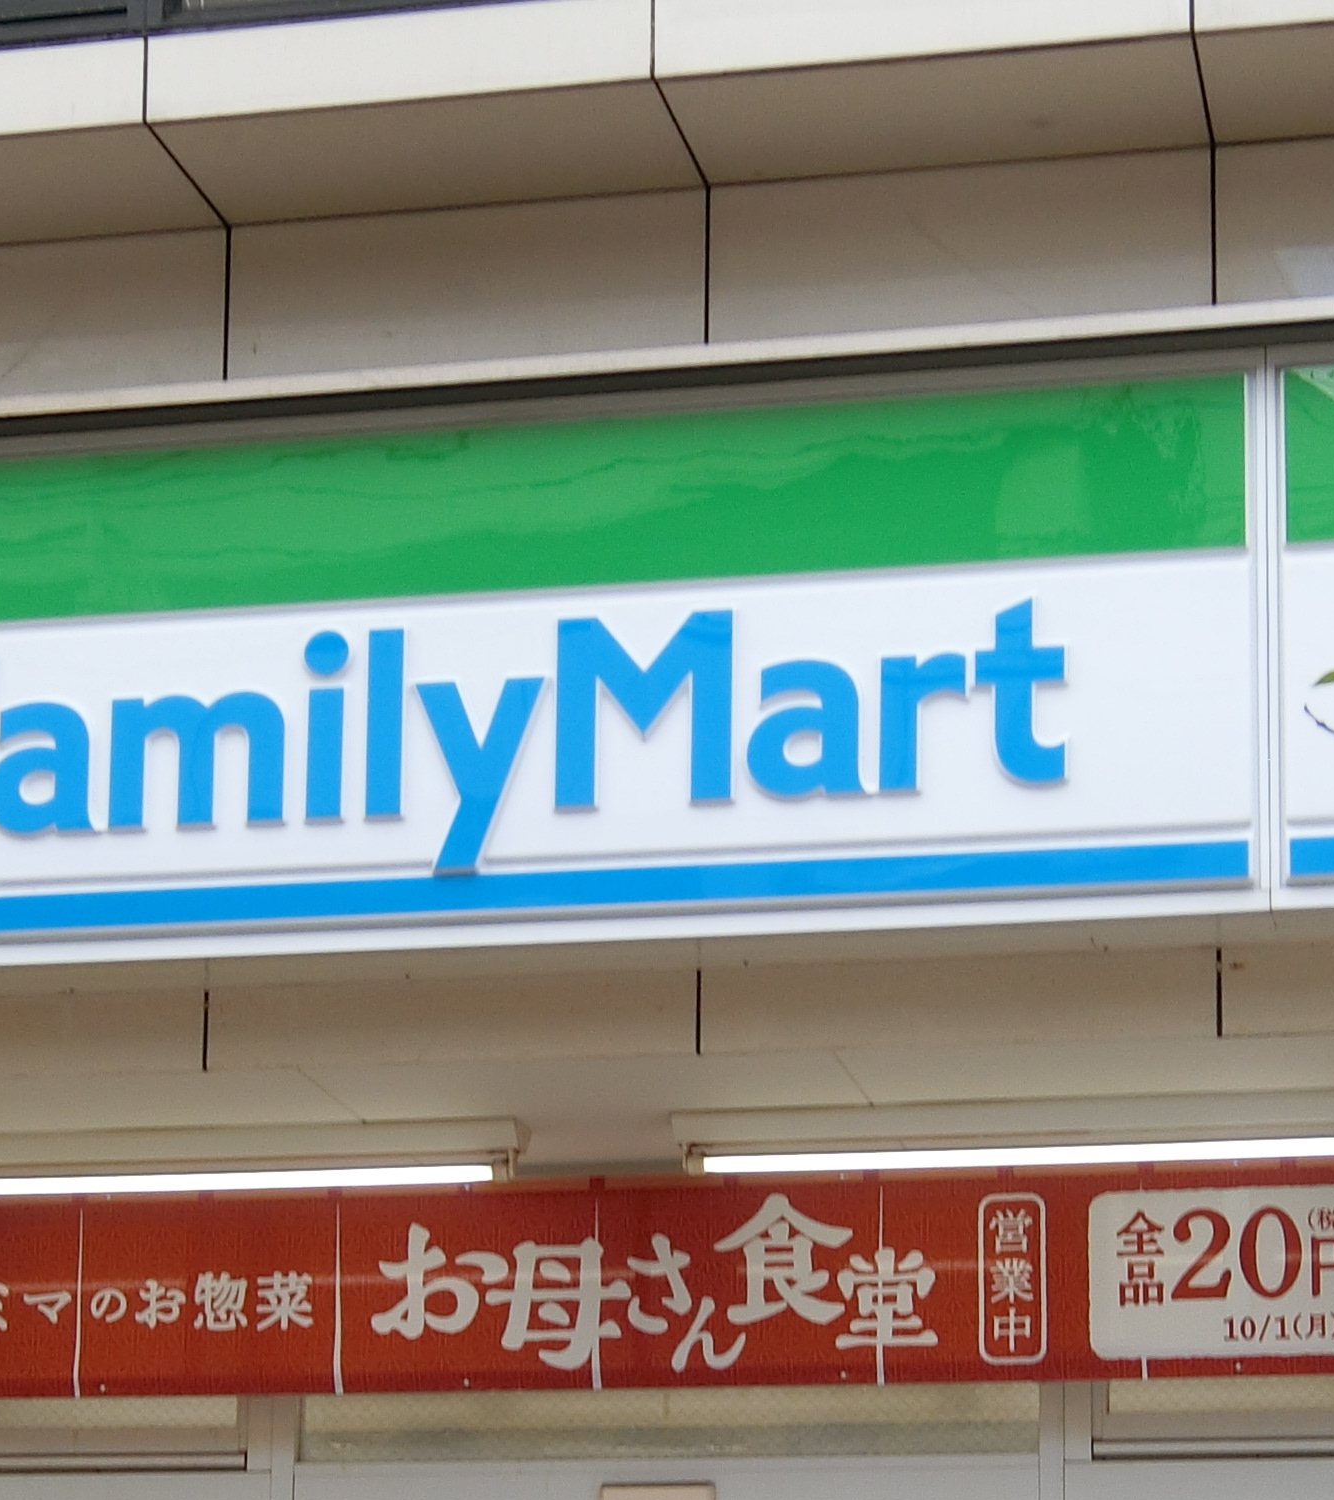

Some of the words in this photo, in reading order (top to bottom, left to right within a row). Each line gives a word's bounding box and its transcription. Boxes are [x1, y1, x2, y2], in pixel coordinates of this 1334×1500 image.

[370, 1192, 939, 1374] お母さん食堂
[987, 1207, 1035, 1354] 営業中
